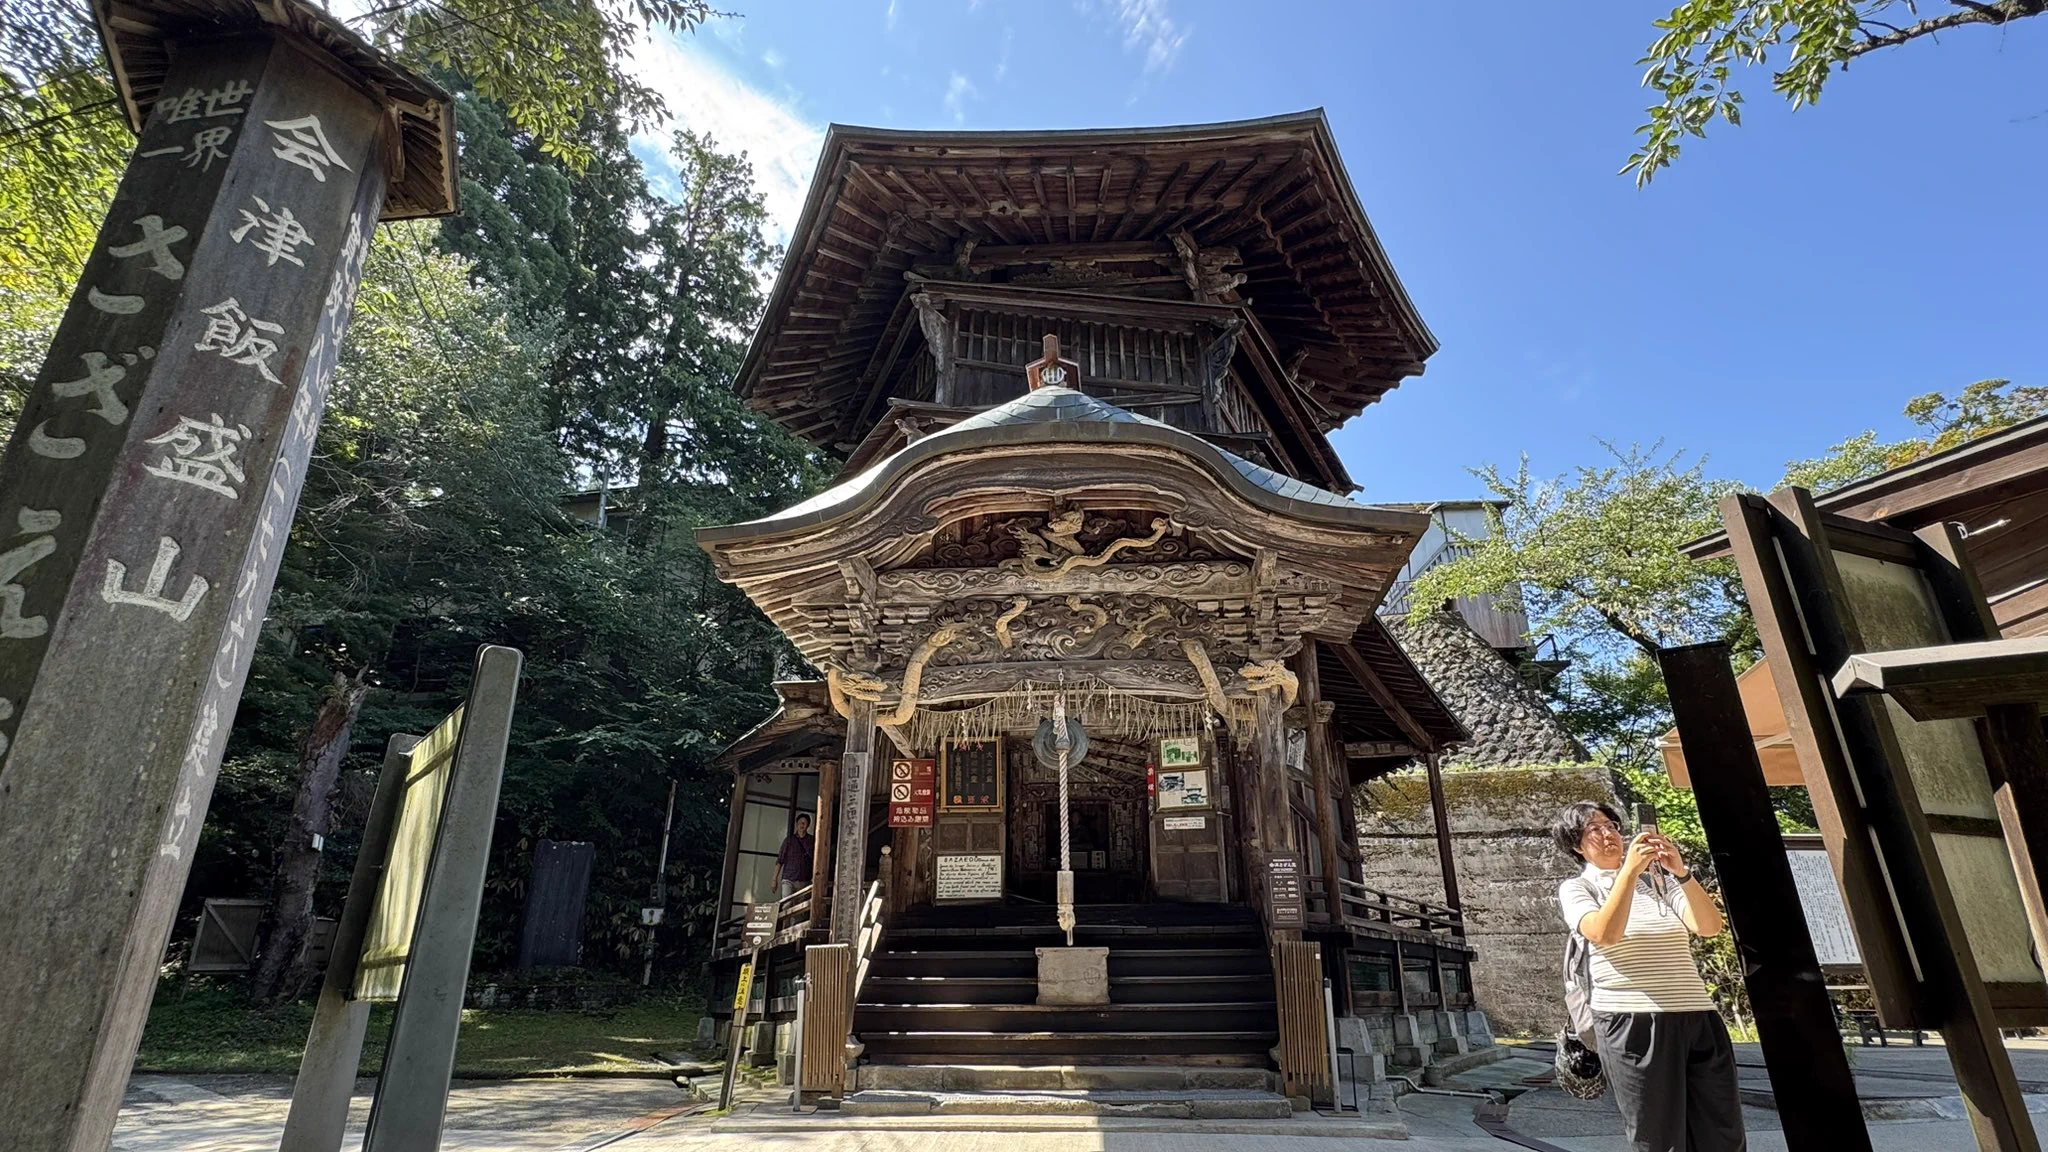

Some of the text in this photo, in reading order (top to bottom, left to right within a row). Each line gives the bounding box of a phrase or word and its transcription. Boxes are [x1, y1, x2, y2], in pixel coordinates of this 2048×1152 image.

[140, 87, 205, 158] 唯一
[180, 80, 254, 173] 世界
[0, 215, 188, 757] さざえ
[102, 114, 353, 622] 会津飯盛山
